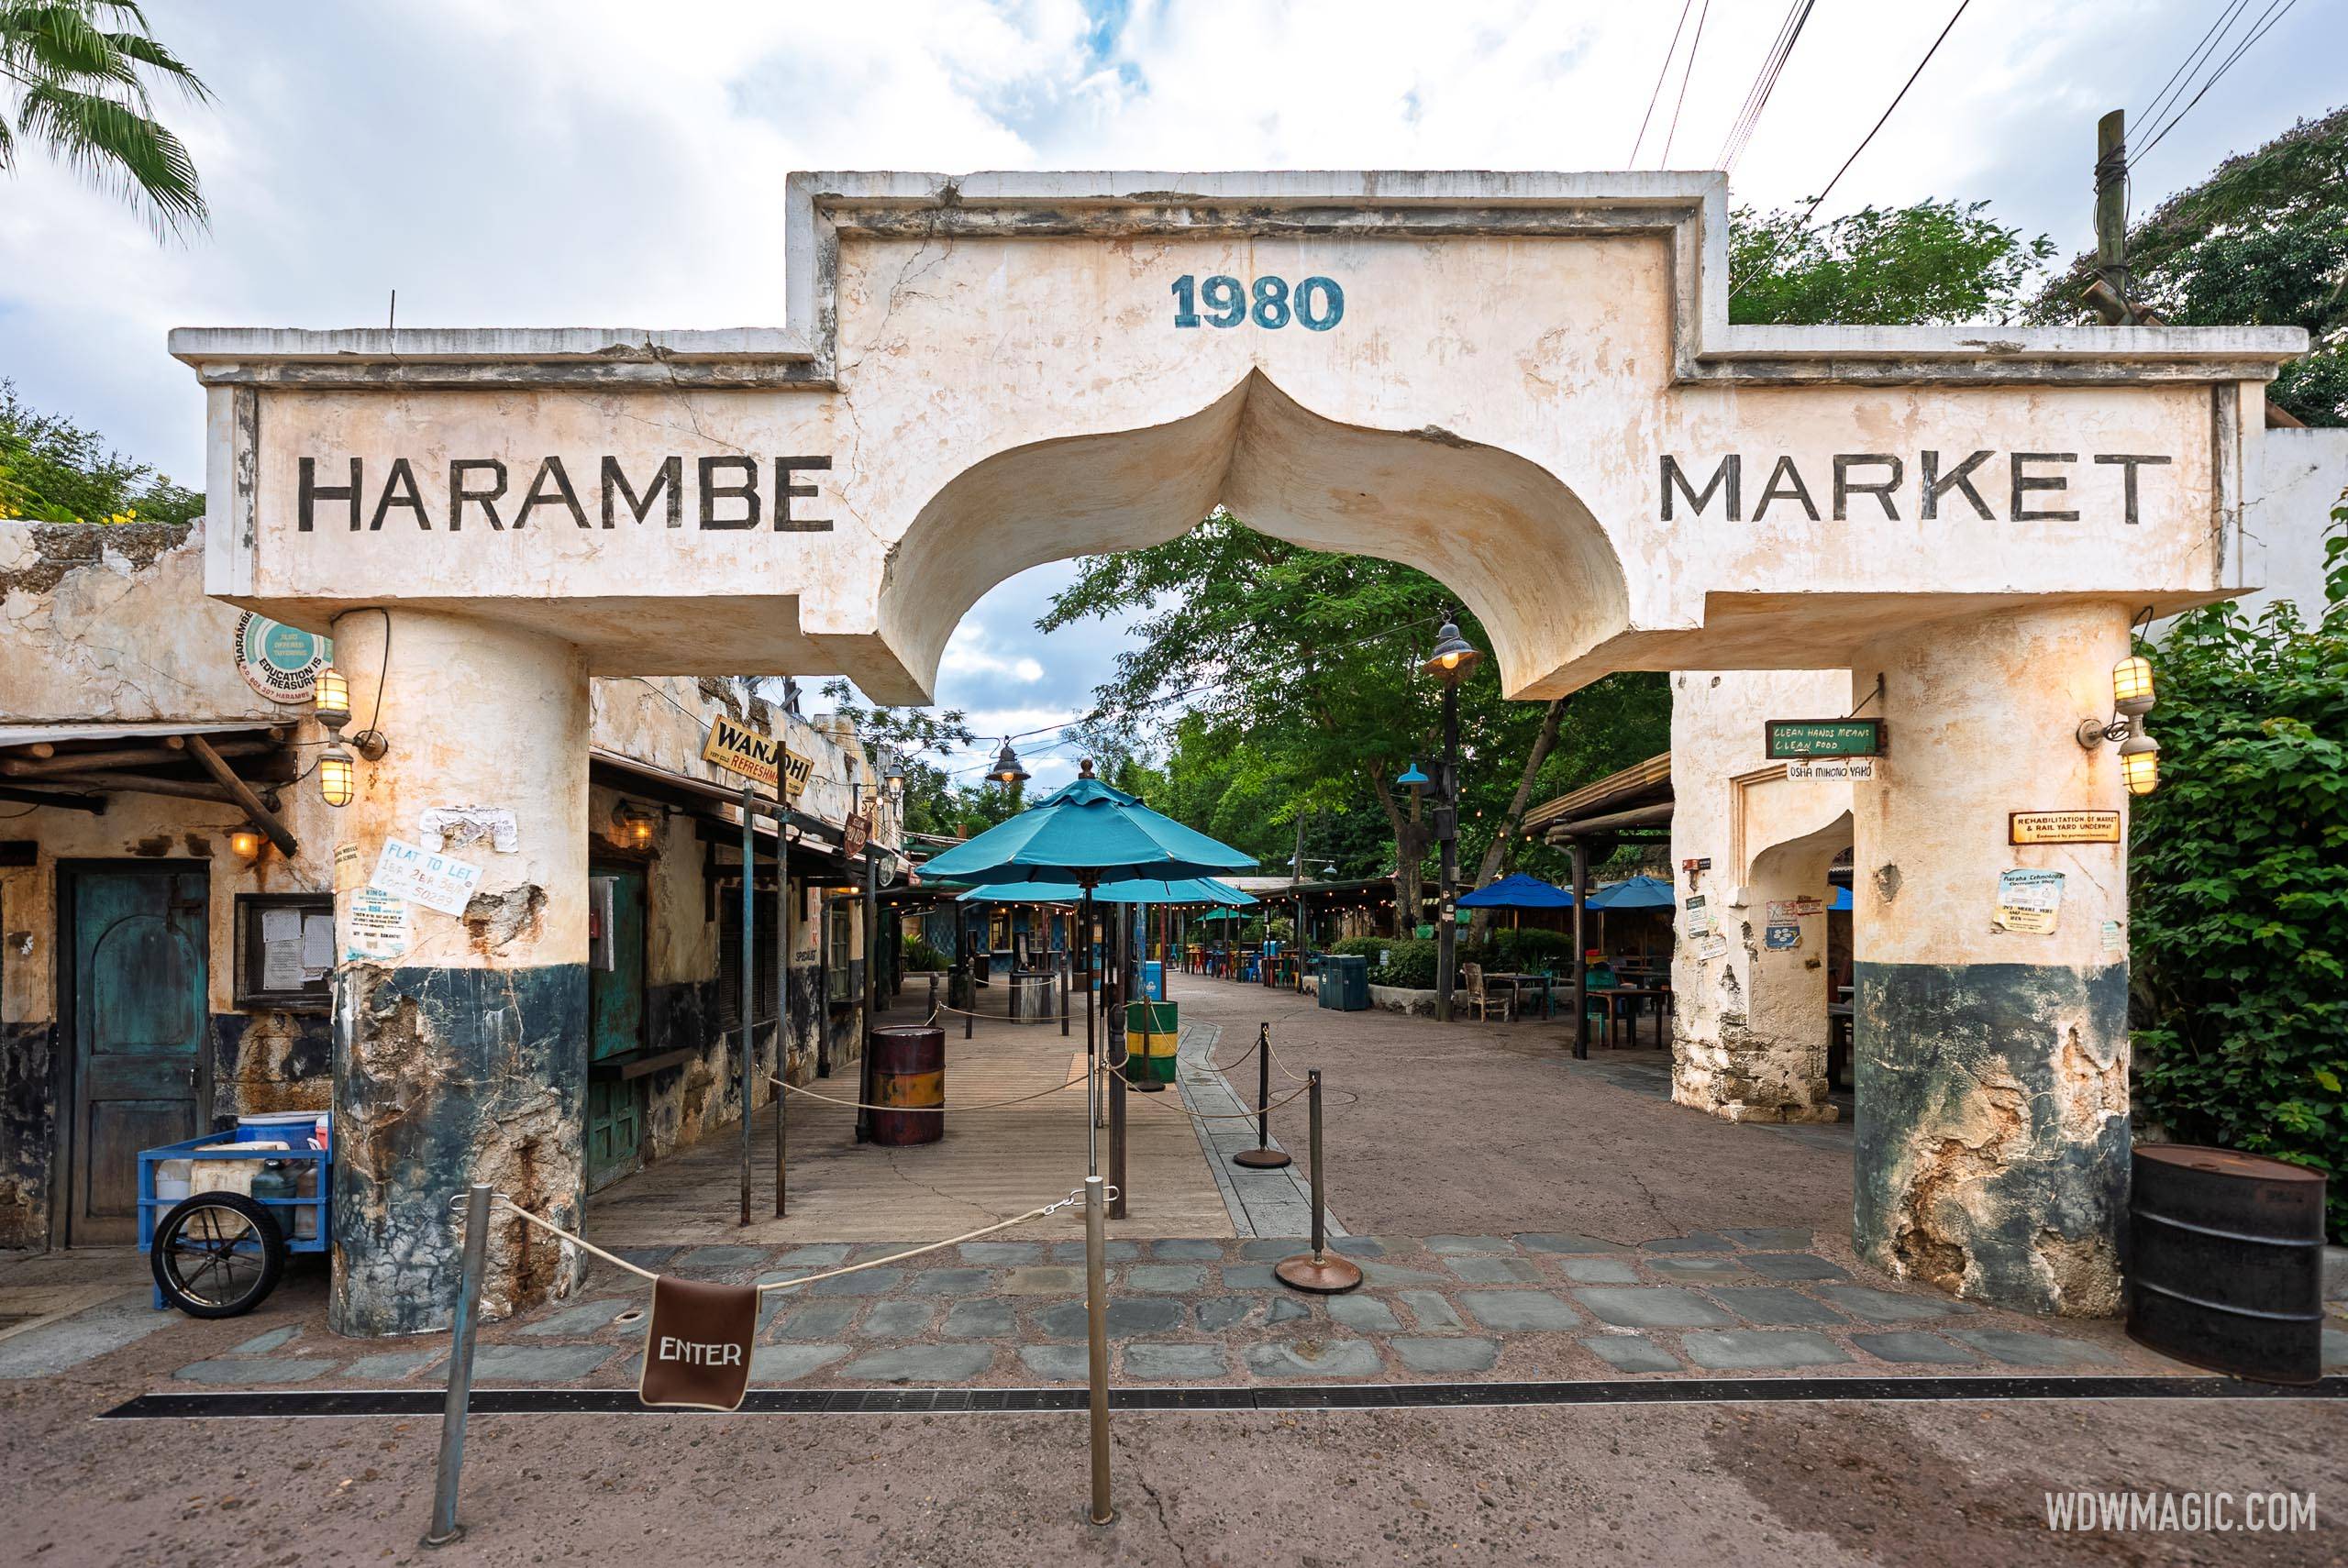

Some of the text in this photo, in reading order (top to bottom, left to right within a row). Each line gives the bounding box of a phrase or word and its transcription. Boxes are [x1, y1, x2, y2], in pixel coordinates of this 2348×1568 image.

[1171, 274, 1345, 331] 1980
[298, 455, 834, 532] HARAMBE
[1659, 450, 2172, 525] MARKET
[236, 610, 254, 663] HARAMBE
[259, 657, 322, 681] EDUCATION IS
[265, 674, 316, 690] TREASURE
[1774, 728, 1869, 737] CLEAN HANDS MEANS
[1775, 741, 1811, 750] CLEAN
[731, 755, 788, 784] REFRESHME
[1790, 766, 1872, 778] OSHA MIKONO YAKO
[2018, 816, 2084, 824] REHABILITATION
[388, 844, 474, 880] FLAT TO LET
[659, 1336, 742, 1366] ENTER
